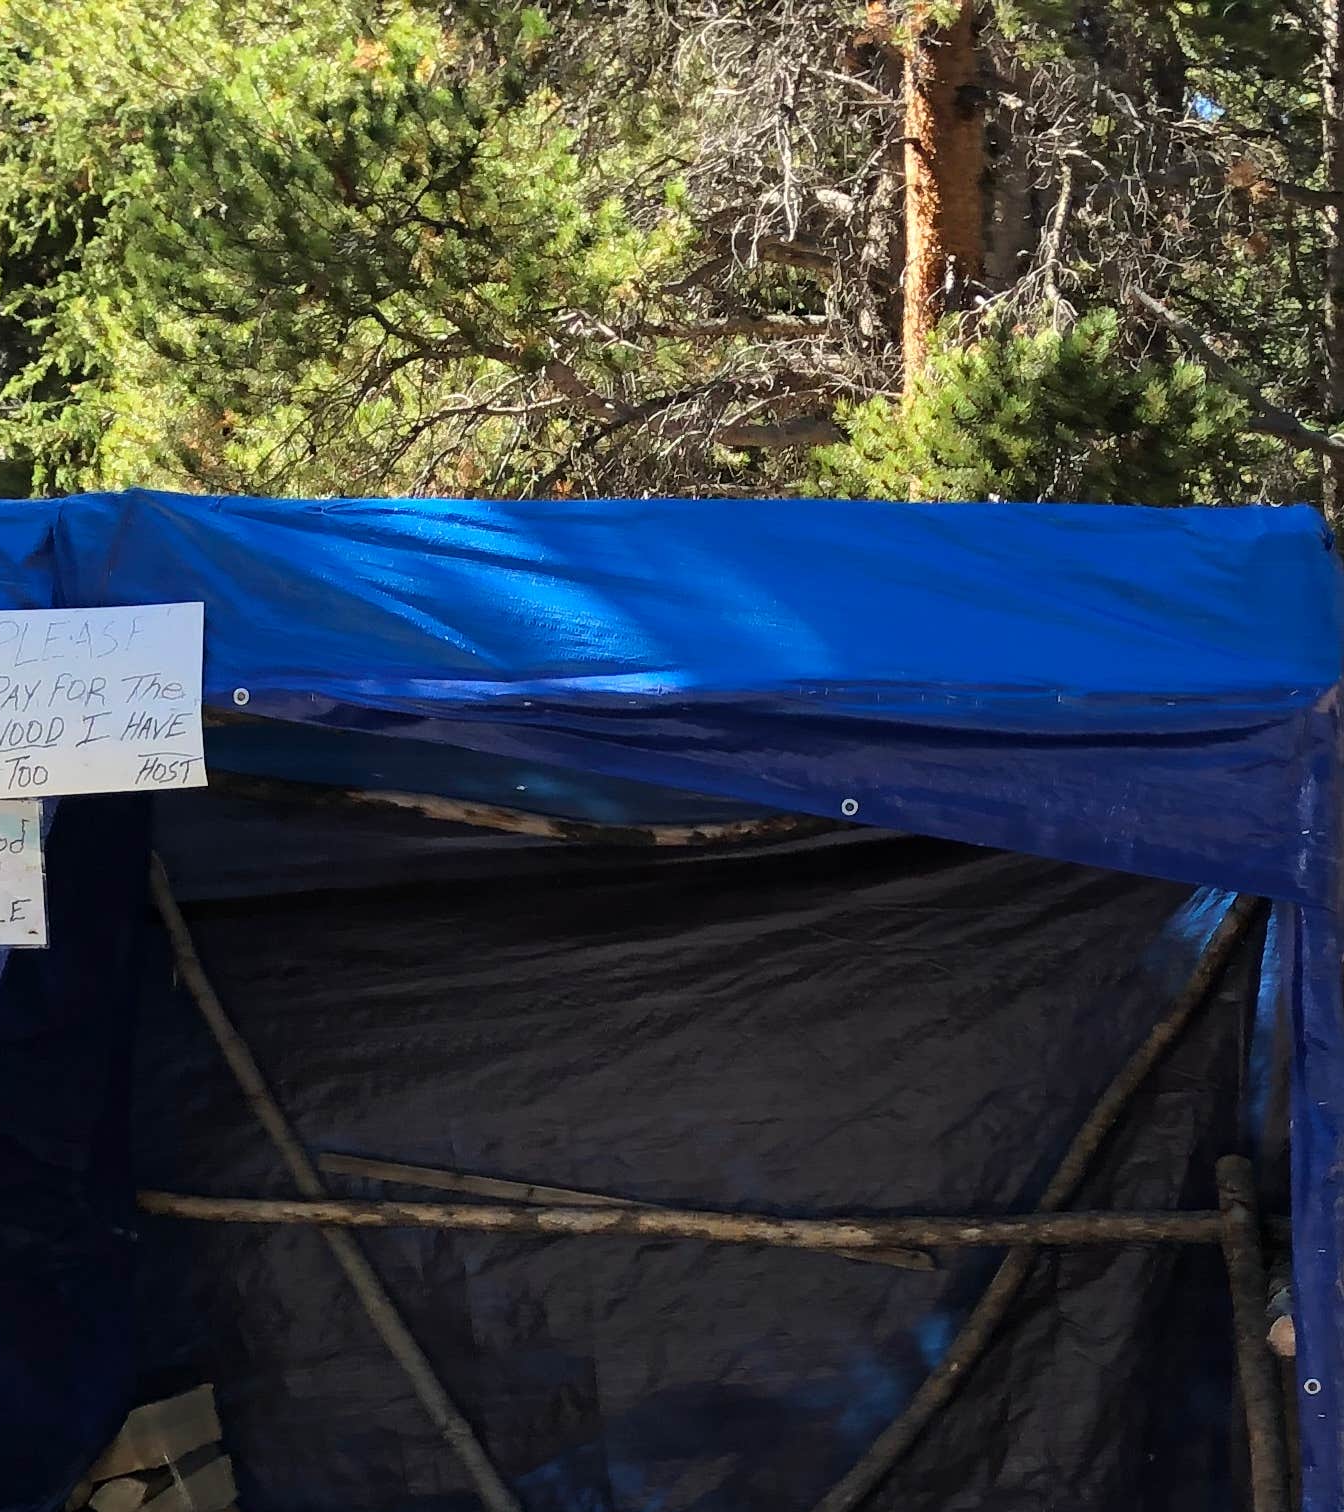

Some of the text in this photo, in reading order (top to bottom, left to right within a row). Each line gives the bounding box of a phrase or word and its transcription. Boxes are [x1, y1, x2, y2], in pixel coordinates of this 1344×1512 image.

[48, 673, 106, 707] FOR
[121, 673, 185, 703] The
[76, 712, 112, 747] I
[120, 712, 193, 741] HAVE
[135, 757, 203, 784] HOST
